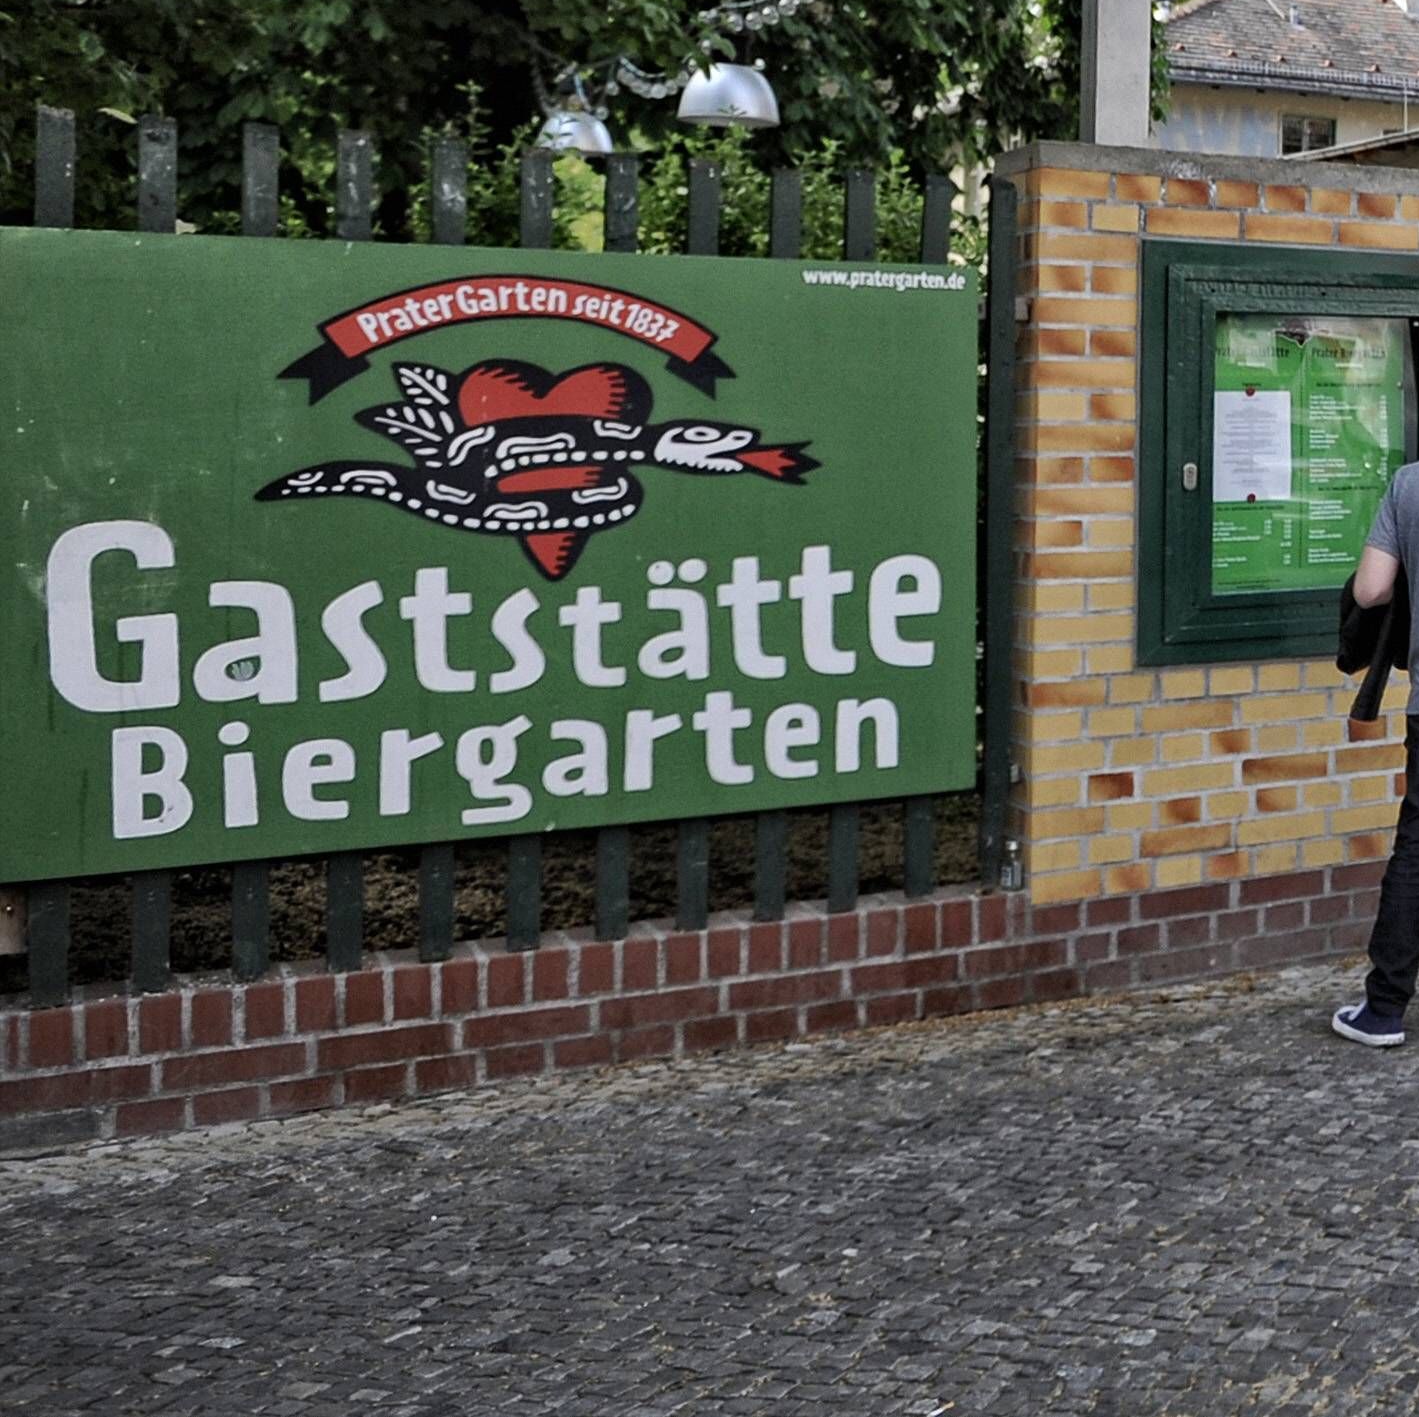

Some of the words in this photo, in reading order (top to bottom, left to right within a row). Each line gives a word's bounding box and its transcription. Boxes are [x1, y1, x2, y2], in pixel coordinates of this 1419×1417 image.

[355, 292, 455, 344] Prater
[455, 282, 567, 315] Garten
[571, 294, 628, 325] seit
[626, 302, 680, 343] 1837
[802, 267, 967, 291] www.pratergarten.de
[47, 519, 944, 715] Gaststätte
[111, 688, 900, 841] Biergarten
